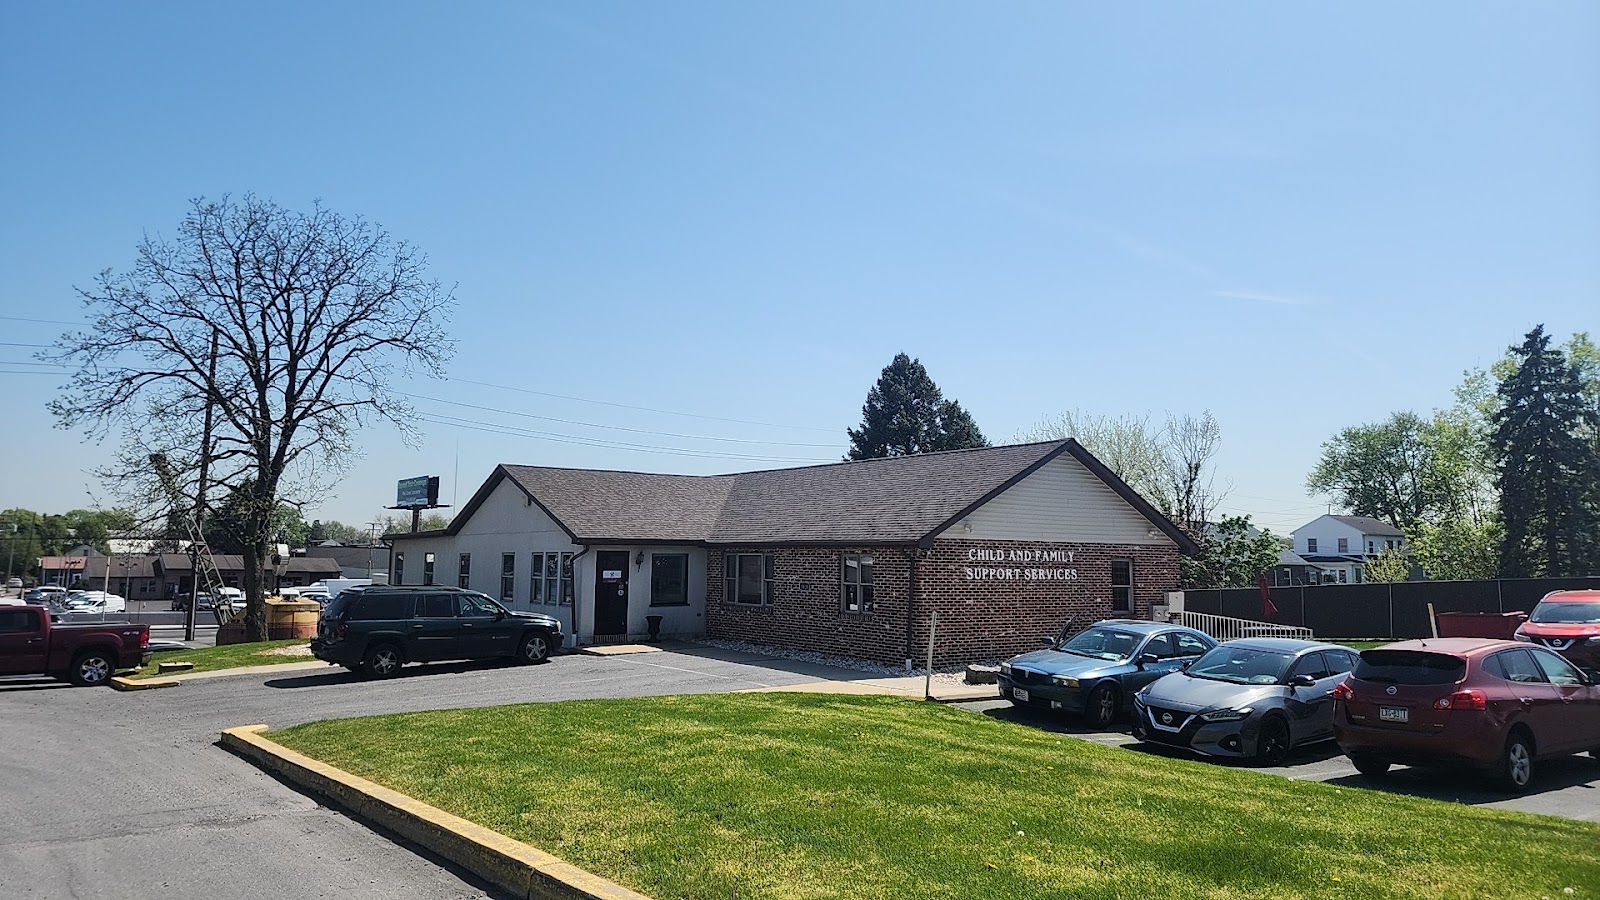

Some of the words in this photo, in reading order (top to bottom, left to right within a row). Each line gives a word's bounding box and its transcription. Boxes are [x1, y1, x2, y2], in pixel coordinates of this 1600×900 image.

[968, 549, 1005, 561] CHILD
[1008, 550, 1032, 561] AND
[1035, 550, 1075, 562] FAMILY
[966, 568, 1021, 580] SUPPORT
[1024, 568, 1078, 580] SERVICES
